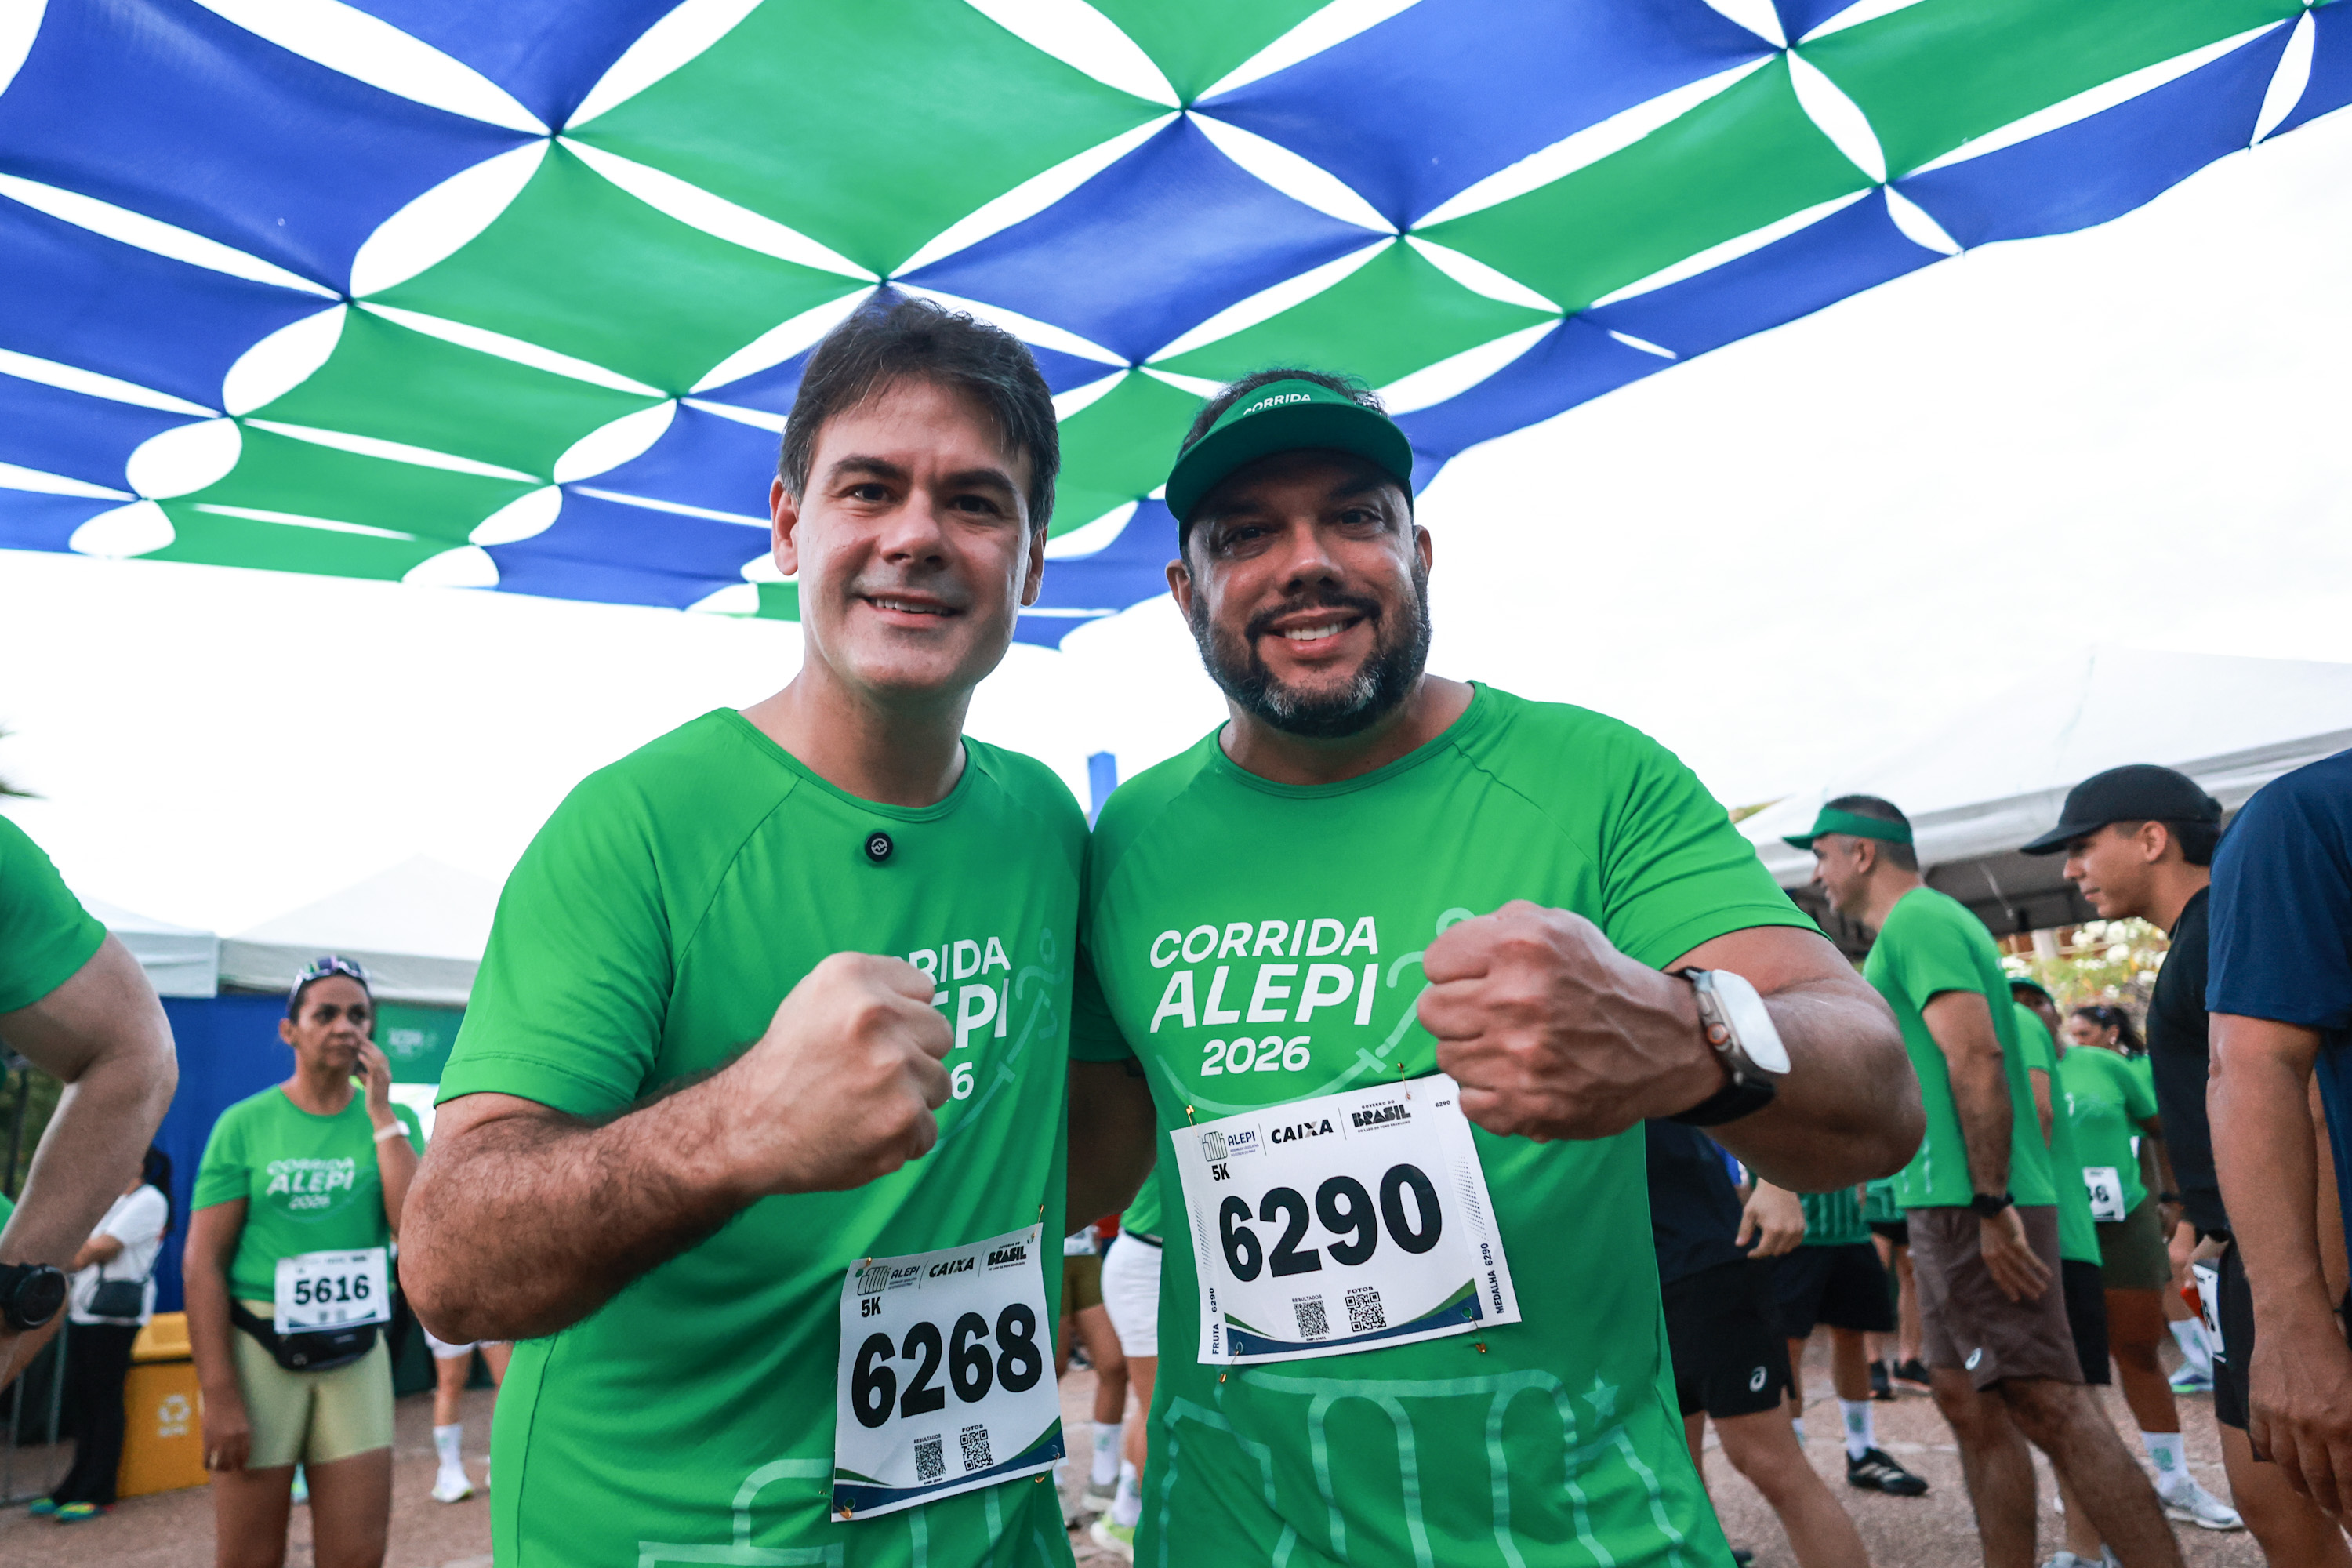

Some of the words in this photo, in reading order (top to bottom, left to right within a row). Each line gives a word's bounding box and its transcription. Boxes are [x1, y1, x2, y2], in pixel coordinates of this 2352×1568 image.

[1150, 916, 1378, 968] CORRIDA
[1150, 963, 1379, 1033] ALEPI
[1200, 1036, 1311, 1076] 2026
[1352, 1105, 1411, 1127] BRASIL
[1228, 1131, 1256, 1146] ALEPI
[1271, 1119, 1334, 1144] CAIXA
[267, 1170, 354, 1196] ALEPI
[1212, 1163, 1231, 1181] 5K
[1219, 1163, 1443, 1282] 6290
[988, 1246, 1026, 1266] BRASIL
[1480, 1243, 1494, 1266] 6290
[891, 1265, 920, 1279] ALEPI
[929, 1257, 975, 1278] CAIXA
[295, 1275, 370, 1305] 5616
[1209, 1287, 1218, 1312] 6290
[1347, 1286, 1374, 1294] FOTOS
[1487, 1270, 1504, 1314] MEDALHA
[861, 1296, 881, 1318] 5K
[851, 1303, 1043, 1428] 6268
[913, 1433, 942, 1444] RESULTADOS
[962, 1424, 984, 1433] FOTOS
